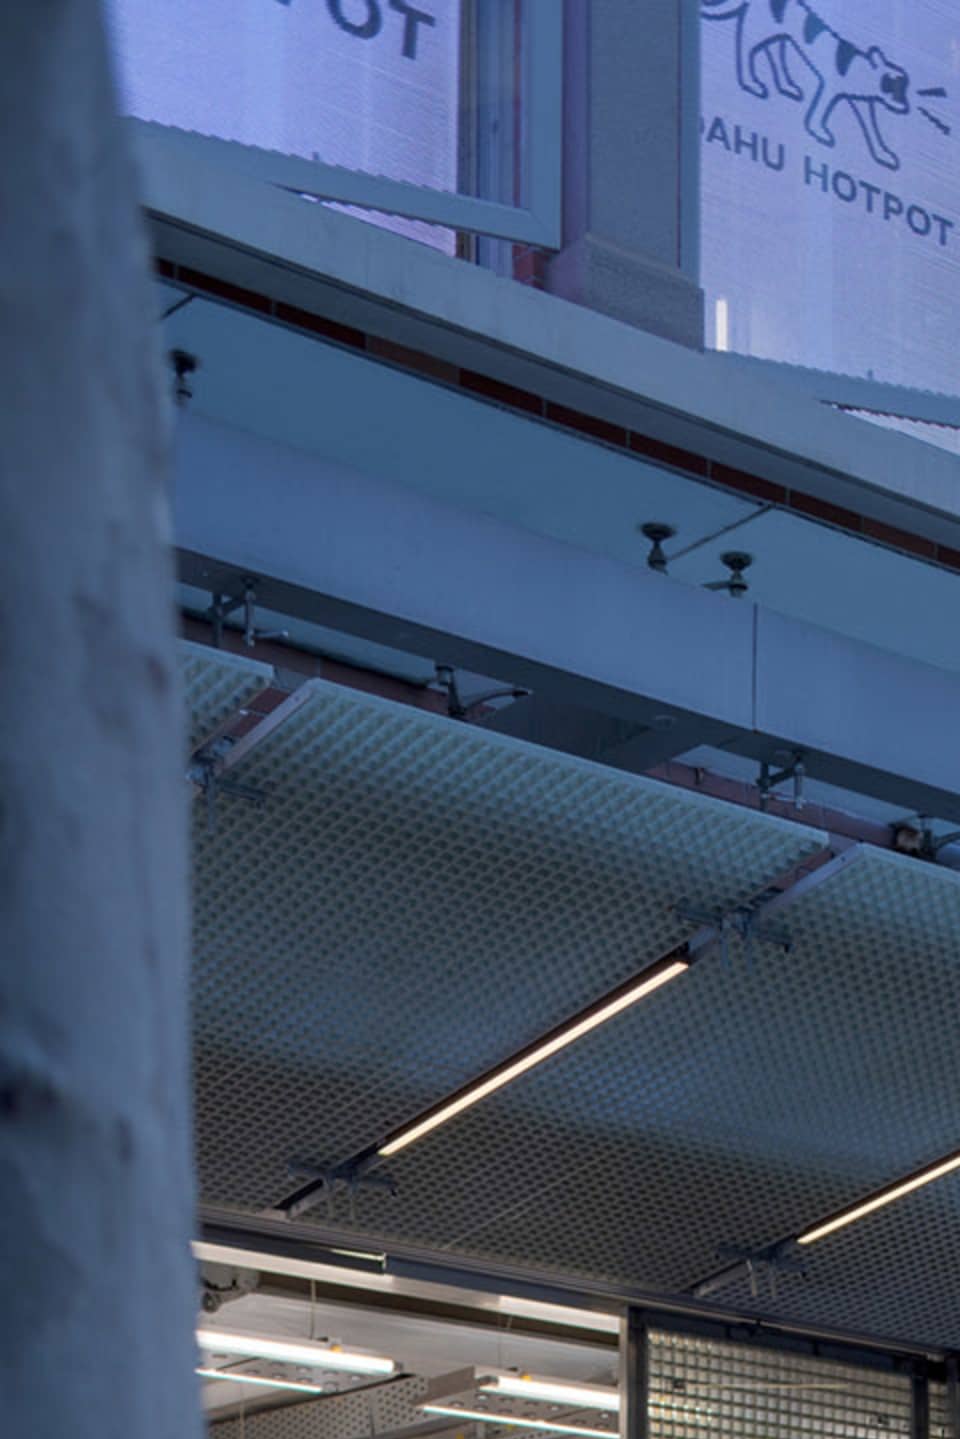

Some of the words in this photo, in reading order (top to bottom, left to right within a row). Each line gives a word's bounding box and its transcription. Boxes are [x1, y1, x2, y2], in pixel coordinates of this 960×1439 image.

[273, 0, 436, 60] OT
[699, 116, 785, 171] AHU
[804, 155, 955, 246] HOTPOT
